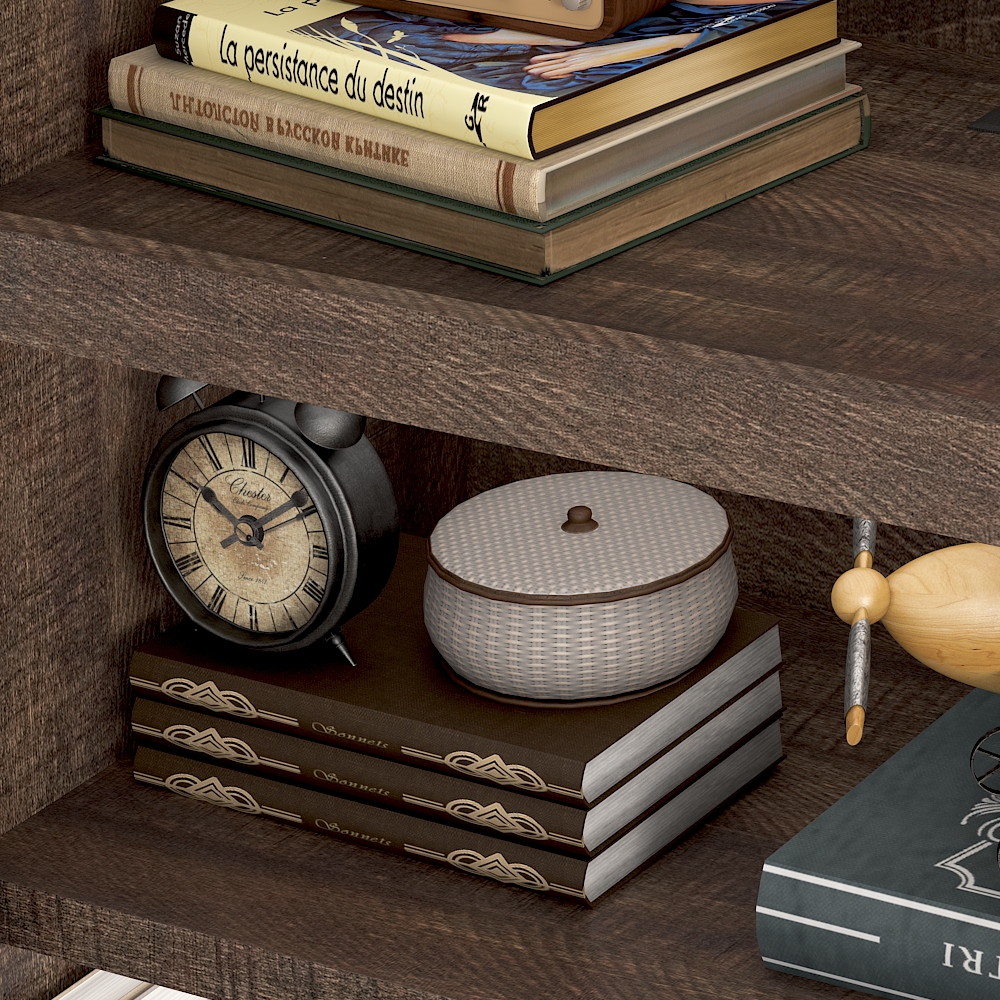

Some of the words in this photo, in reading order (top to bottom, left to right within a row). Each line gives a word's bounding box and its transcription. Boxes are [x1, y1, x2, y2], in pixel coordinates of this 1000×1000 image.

[263, 5, 298, 17] La
[220, 24, 239, 67] La
[243, 42, 339, 95] persistance
[344, 60, 367, 103] du
[372, 67, 425, 119] destin
[225, 475, 272, 502] Chester
[311, 721, 389, 749] Sonnets
[313, 769, 391, 796] Sonnets
[314, 818, 392, 846] Sonnets
